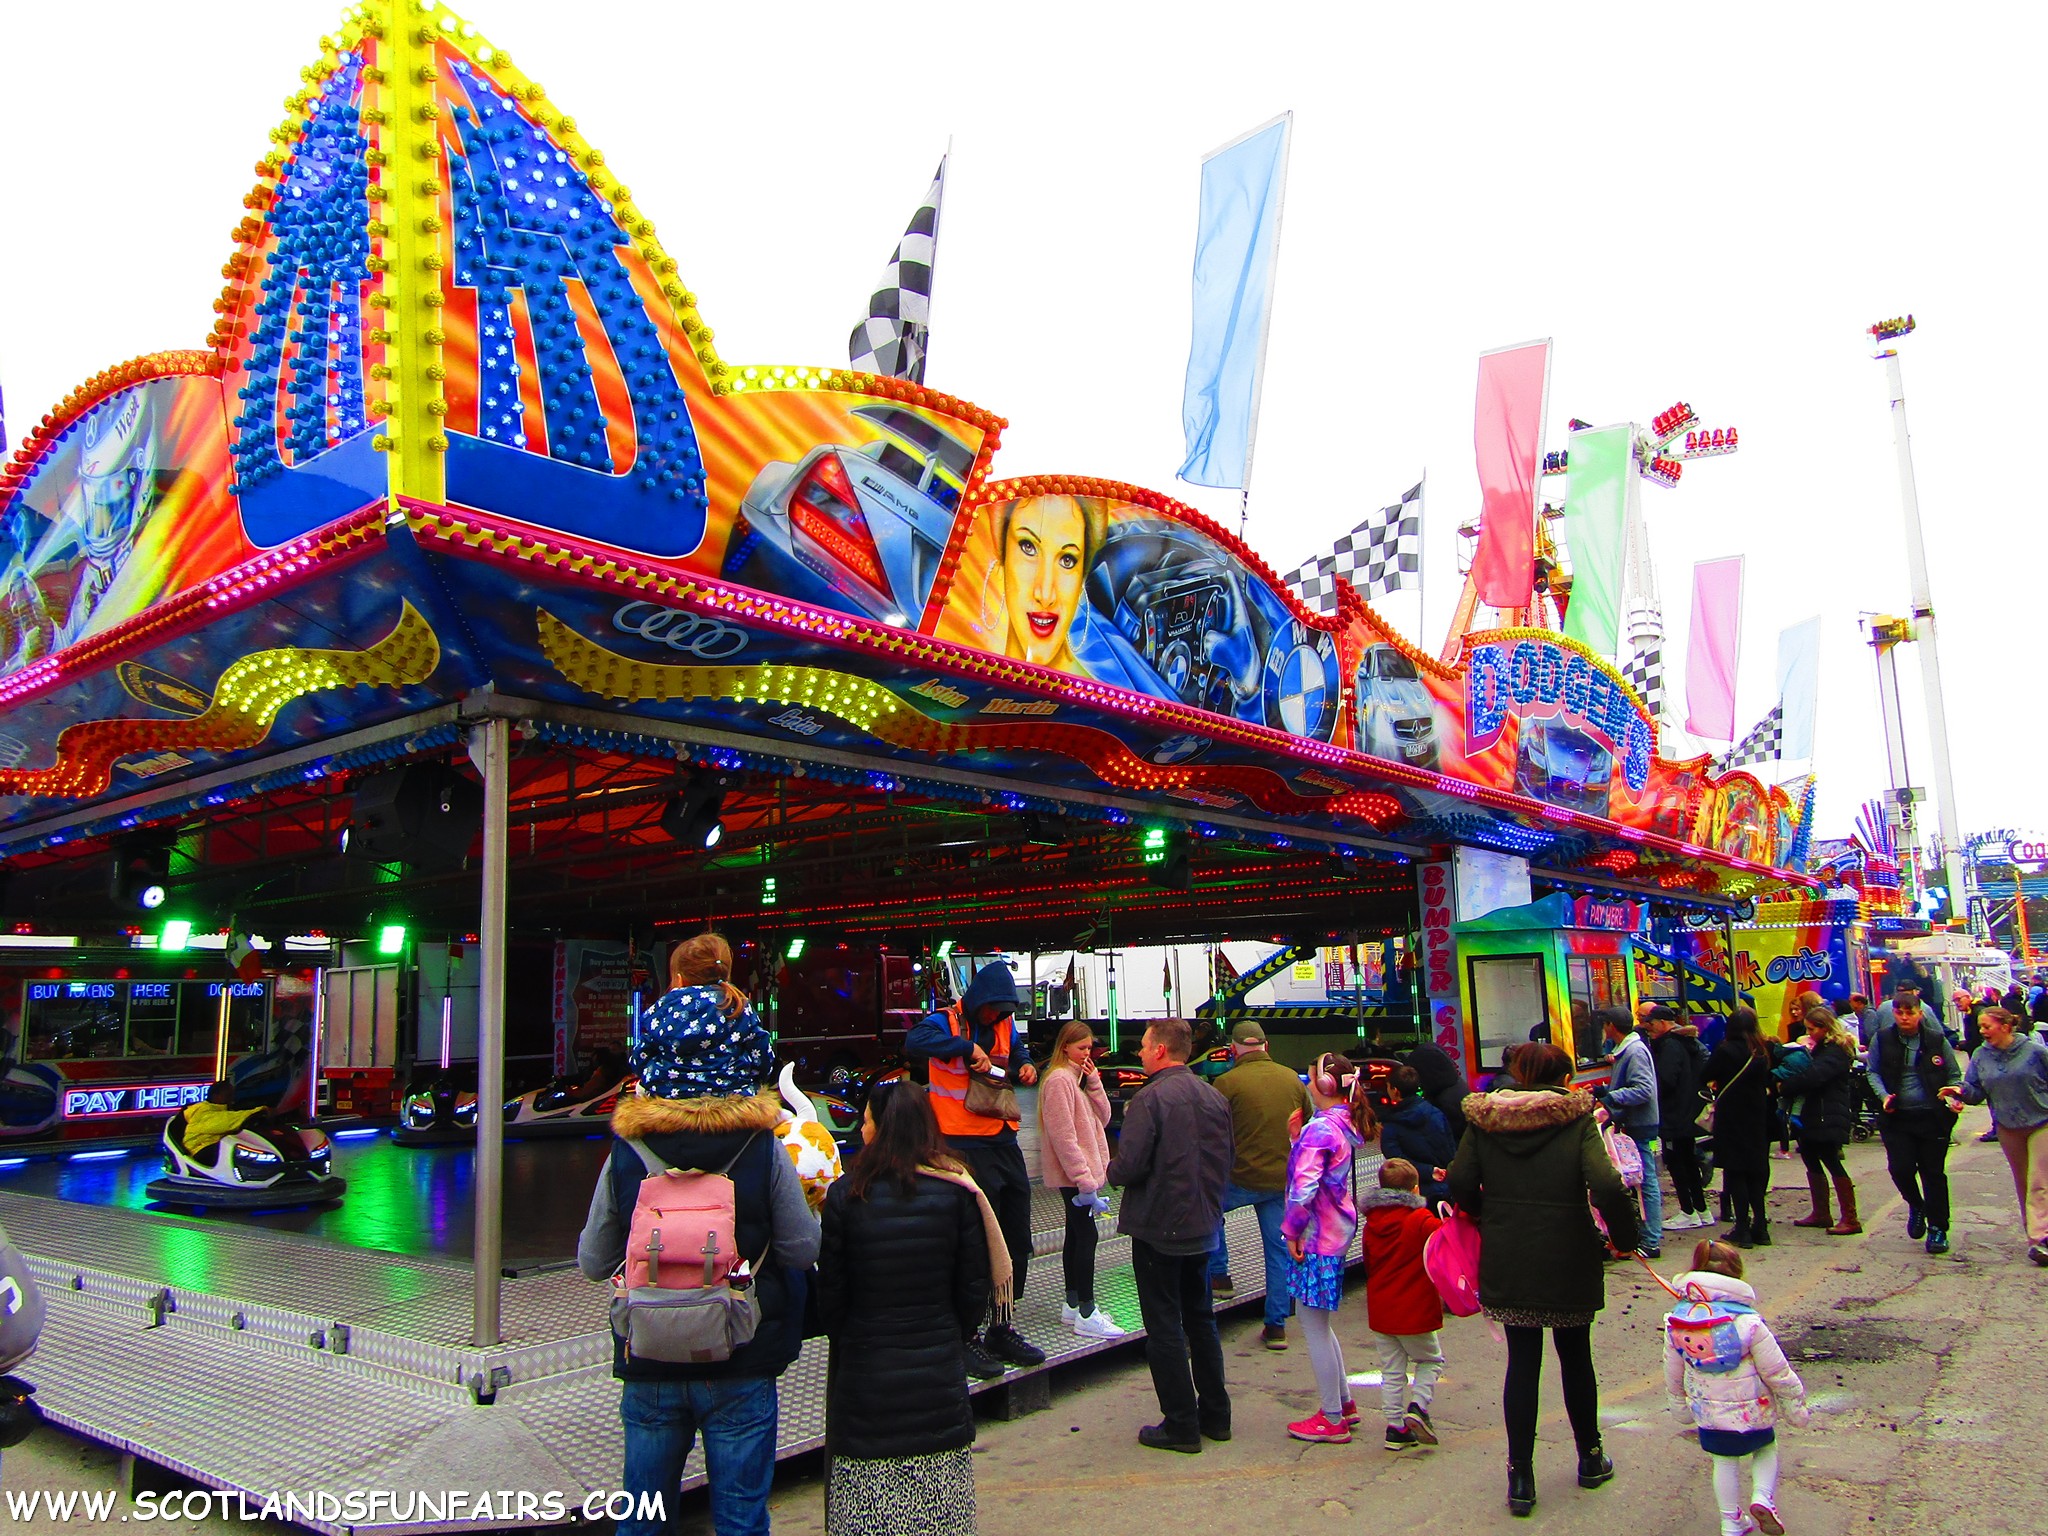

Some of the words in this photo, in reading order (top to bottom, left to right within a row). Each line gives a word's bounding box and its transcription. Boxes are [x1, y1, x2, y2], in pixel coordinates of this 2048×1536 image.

[115, 395, 140, 441] West
[882, 489, 919, 520] AMG
[1269, 621, 1333, 678] BMW
[909, 678, 970, 708] Aston
[979, 698, 1060, 715] Martin
[1472, 641, 1652, 791] DODGEMS
[1423, 866, 1452, 992] BUMPER
[1590, 905, 1604, 925] PAY
[1605, 906, 1624, 927] HERE
[1765, 946, 1832, 984] out
[33, 984, 60, 999] BUY
[68, 983, 115, 998] TOKENS
[135, 983, 170, 998] HERE
[68, 1090, 126, 1114] PAY
